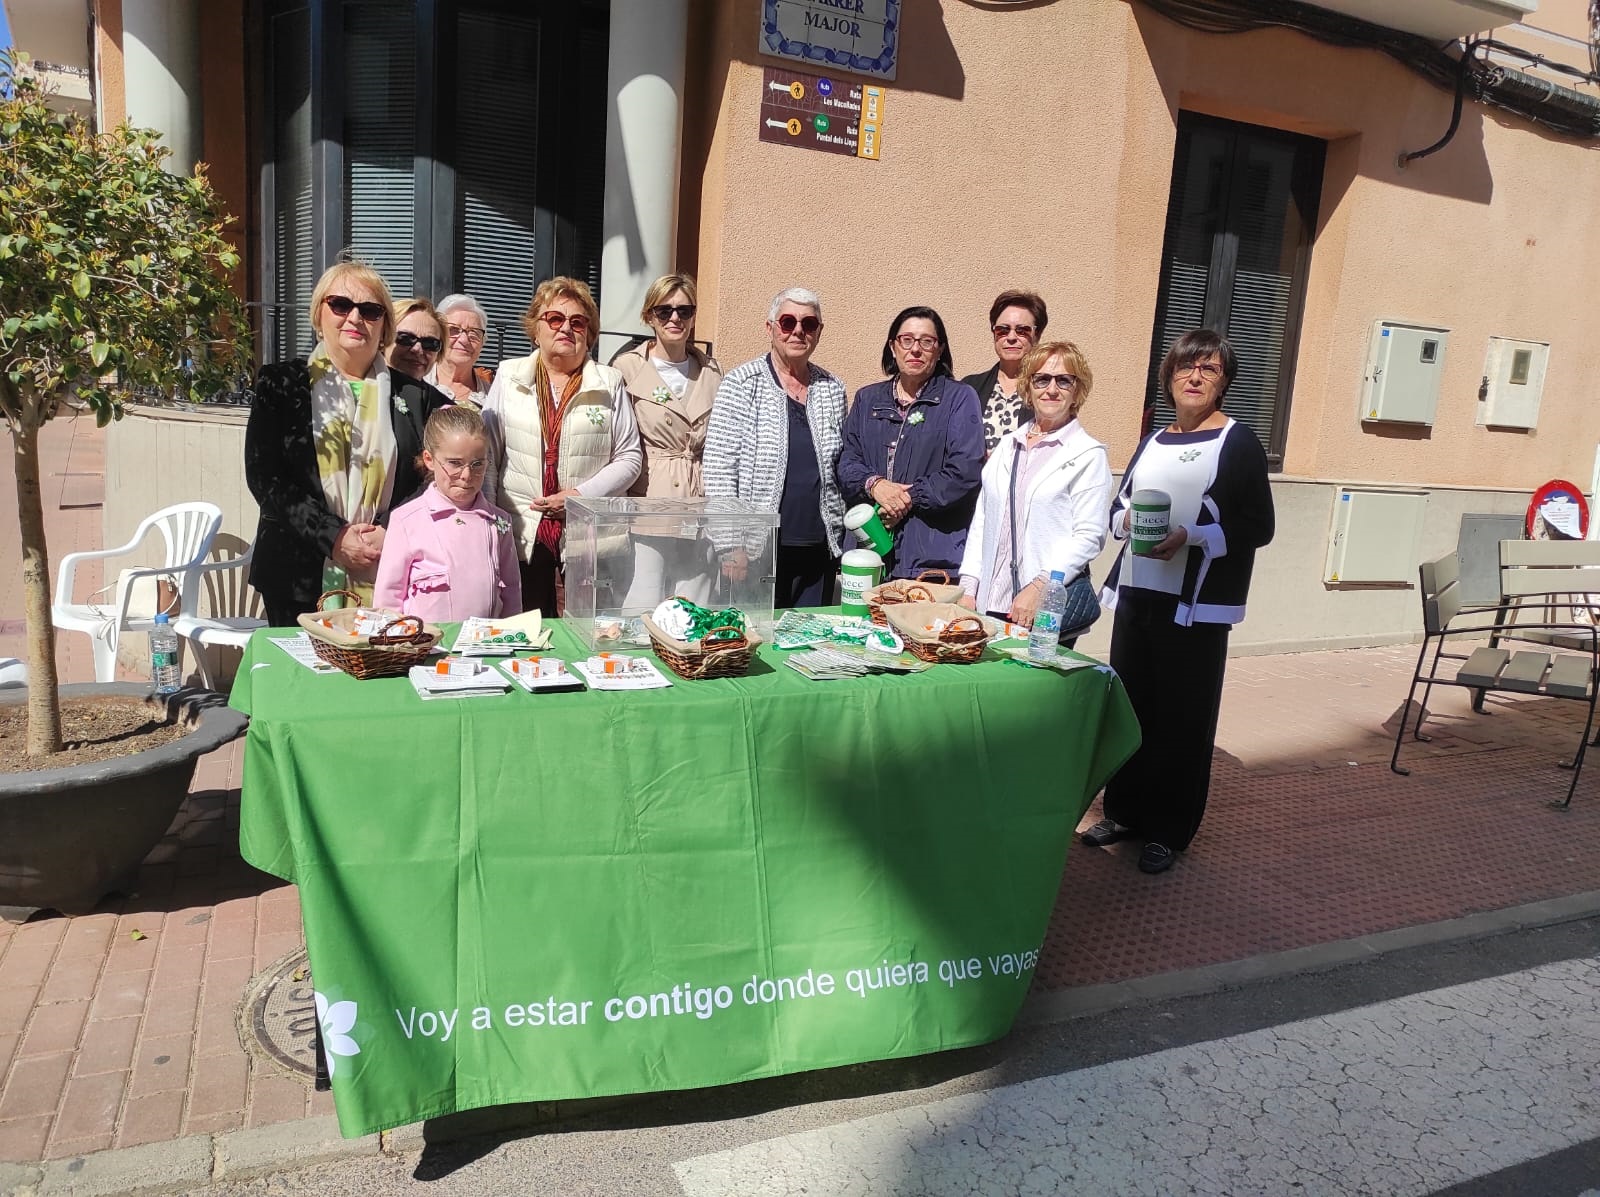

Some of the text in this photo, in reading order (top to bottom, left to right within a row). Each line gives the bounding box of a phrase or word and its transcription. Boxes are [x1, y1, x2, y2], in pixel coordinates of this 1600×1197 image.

[804, 11, 861, 38] MAJOR
[395, 947, 1039, 1041] Voy a estar contigo donde quiera que vayas
